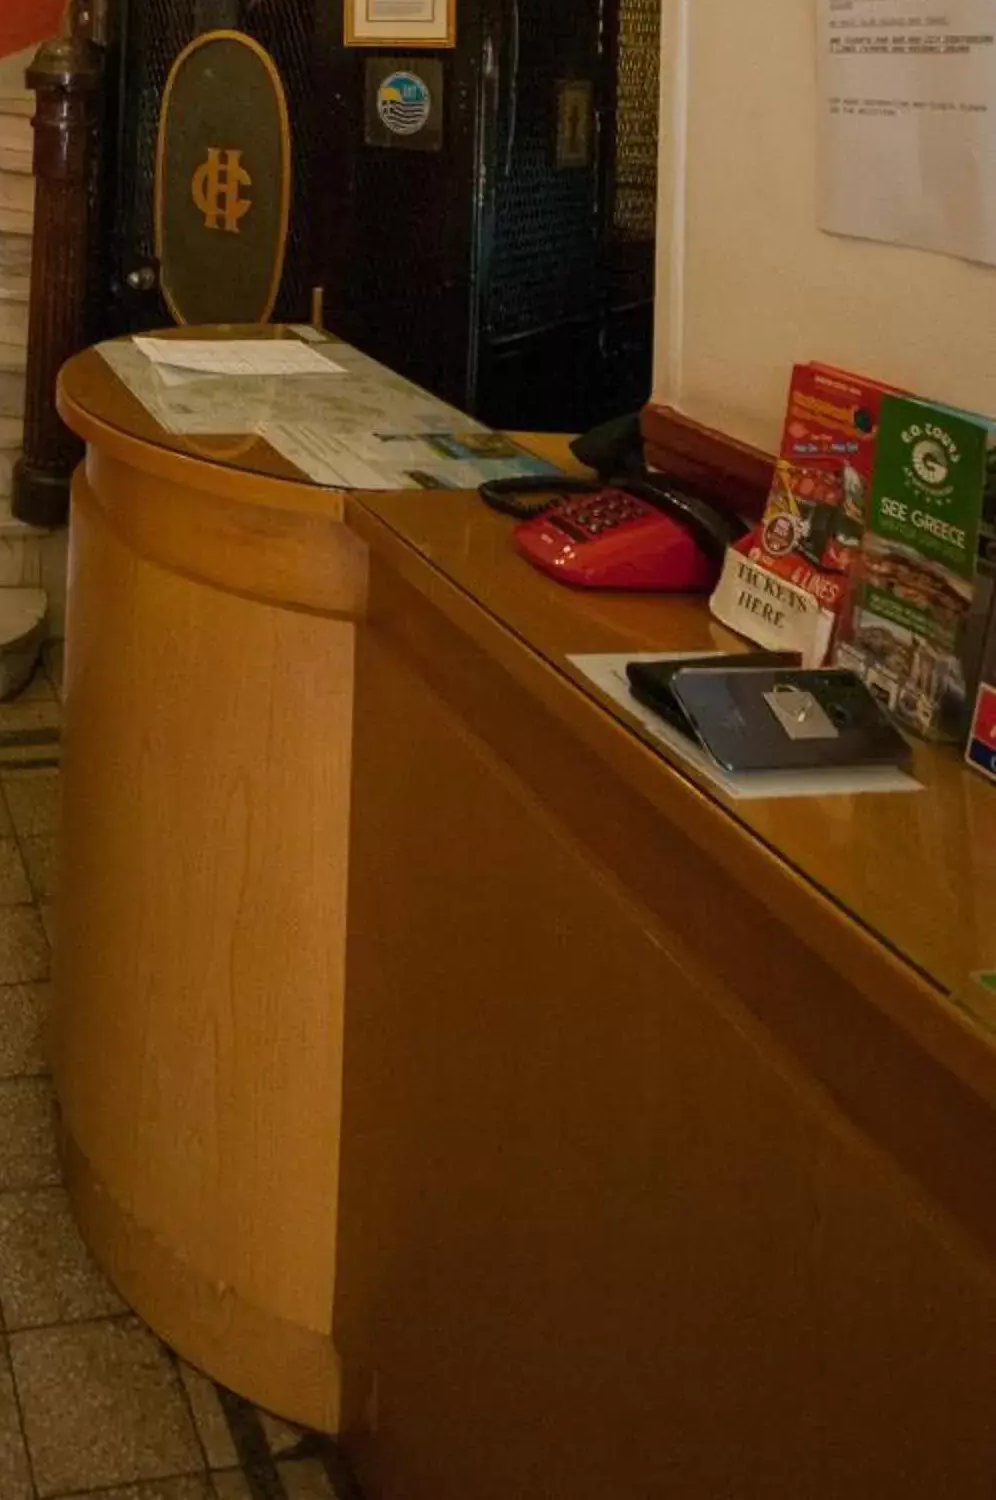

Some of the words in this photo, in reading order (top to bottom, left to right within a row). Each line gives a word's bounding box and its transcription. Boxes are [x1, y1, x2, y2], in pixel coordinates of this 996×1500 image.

[880, 496, 908, 522] SEE
[911, 509, 966, 550] GREECE
[734, 560, 807, 613] TICKETS
[737, 590, 787, 628] HERE
